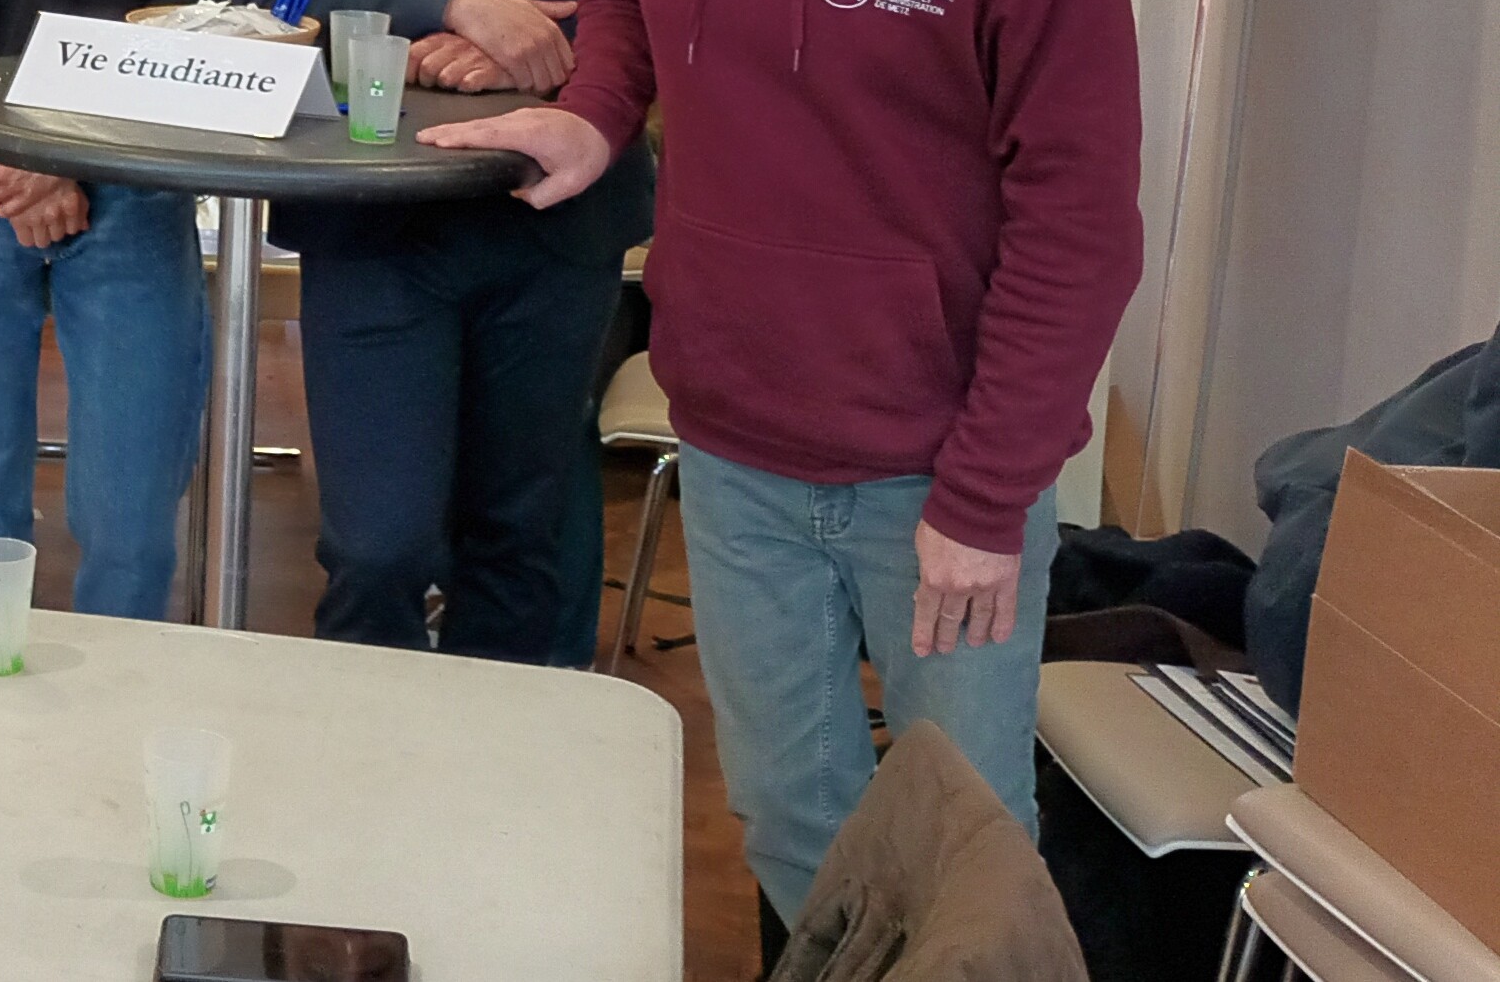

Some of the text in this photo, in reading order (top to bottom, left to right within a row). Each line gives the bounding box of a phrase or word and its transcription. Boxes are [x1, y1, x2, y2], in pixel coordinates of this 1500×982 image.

[874, 0, 911, 16] DE METZ
[57, 41, 276, 93] Vie étudiante
